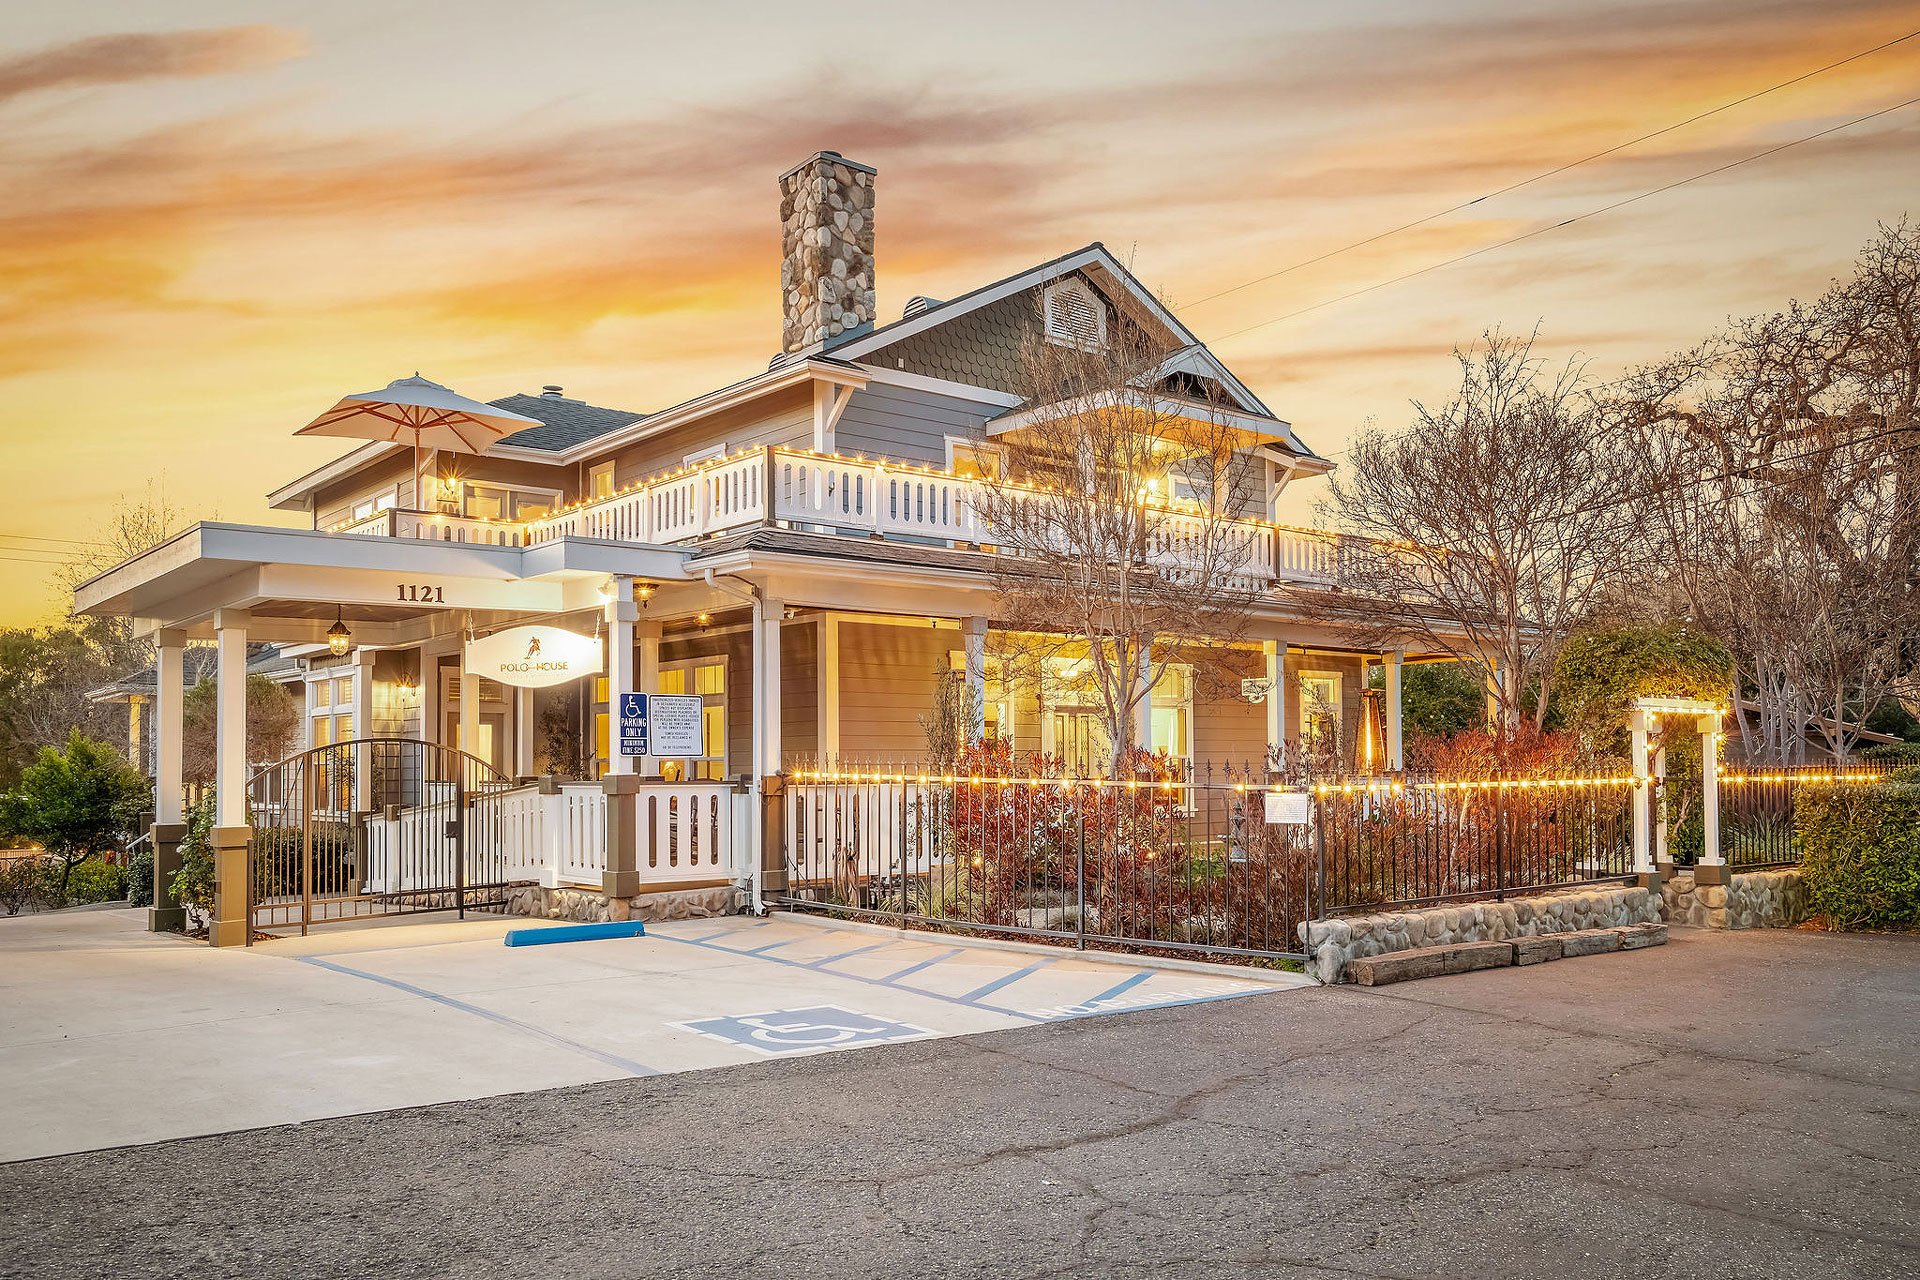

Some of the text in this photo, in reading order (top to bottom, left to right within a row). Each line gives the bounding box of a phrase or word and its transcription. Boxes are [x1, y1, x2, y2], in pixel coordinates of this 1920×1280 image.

[396, 584, 445, 604] 1121
[500, 661, 568, 673] POLO HOUSE
[620, 717, 647, 727] PARKING
[625, 727, 642, 737] ONLY
